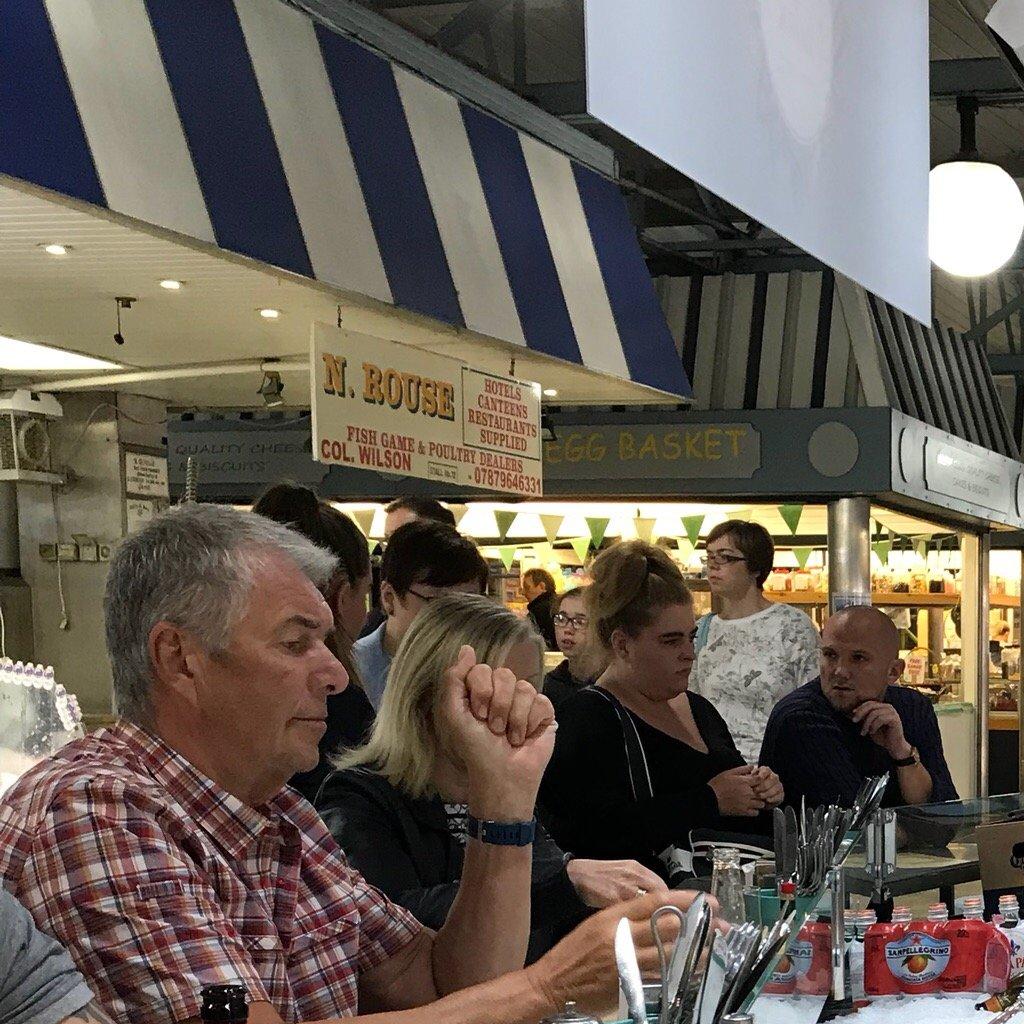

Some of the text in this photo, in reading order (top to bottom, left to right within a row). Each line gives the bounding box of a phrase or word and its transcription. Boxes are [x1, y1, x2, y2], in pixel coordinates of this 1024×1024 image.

[362, 361, 455, 421] ROUSE
[484, 378, 521, 401] HOTELS
[477, 394, 528, 419] CANTEENS
[468, 408, 537, 438] RESTAURANTS
[321, 439, 412, 472] COL. WILSON
[347, 425, 523, 473] FISH GAME & POULTRY DEALERS
[480, 429, 527, 452] SUPPLIED
[545, 425, 747, 464] EGG BASKET
[888, 946, 949, 956] SANPELLEGRINO
